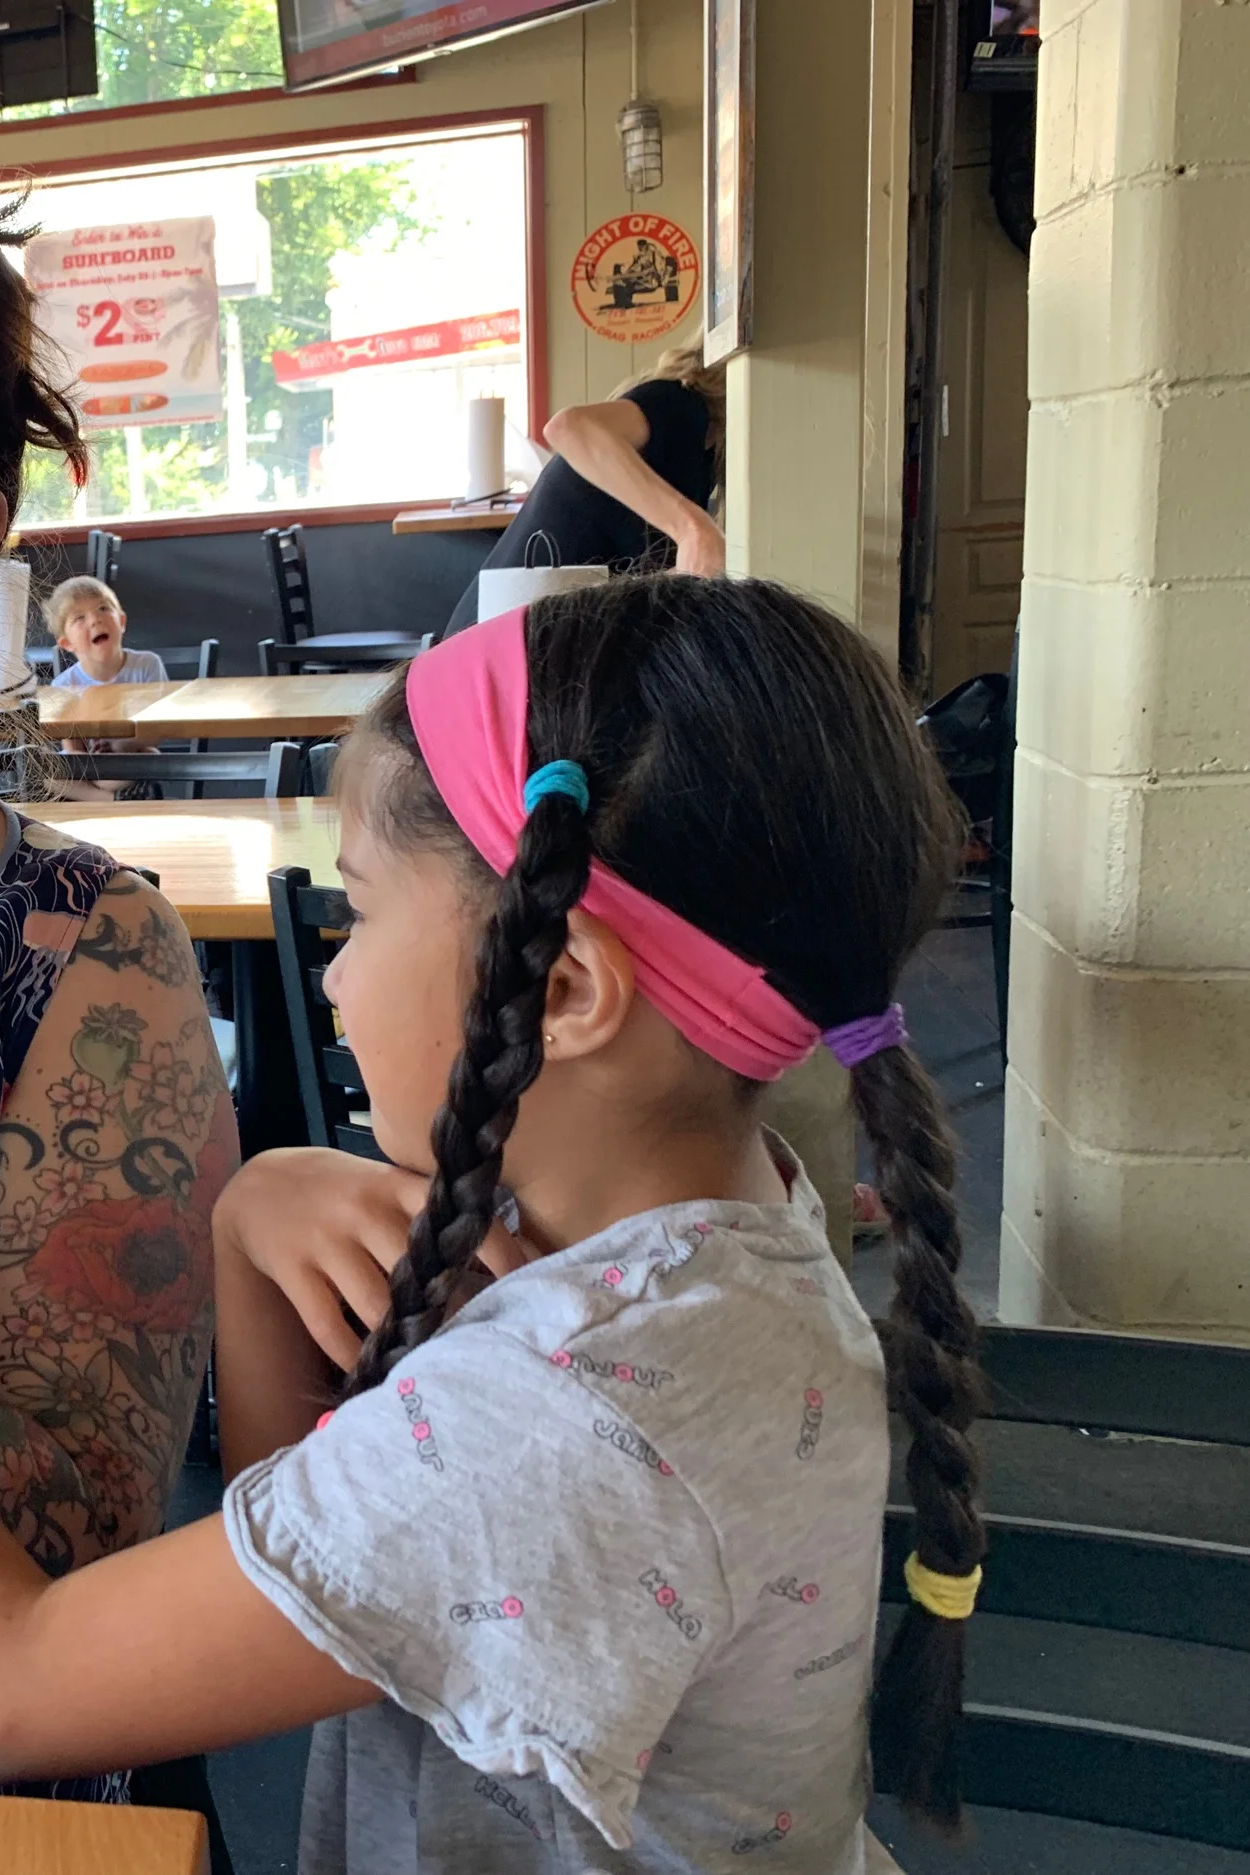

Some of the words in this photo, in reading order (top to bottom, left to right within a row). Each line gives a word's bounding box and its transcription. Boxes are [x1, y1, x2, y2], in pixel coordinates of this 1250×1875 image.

[62, 245, 175, 270] SURFBOARD
[573, 221, 622, 280] NIGHT
[628, 216, 659, 233] OF
[658, 224, 697, 272] FIRE
[76, 300, 124, 347] $2
[596, 326, 626, 343] DRAG
[632, 321, 672, 341] RACING
